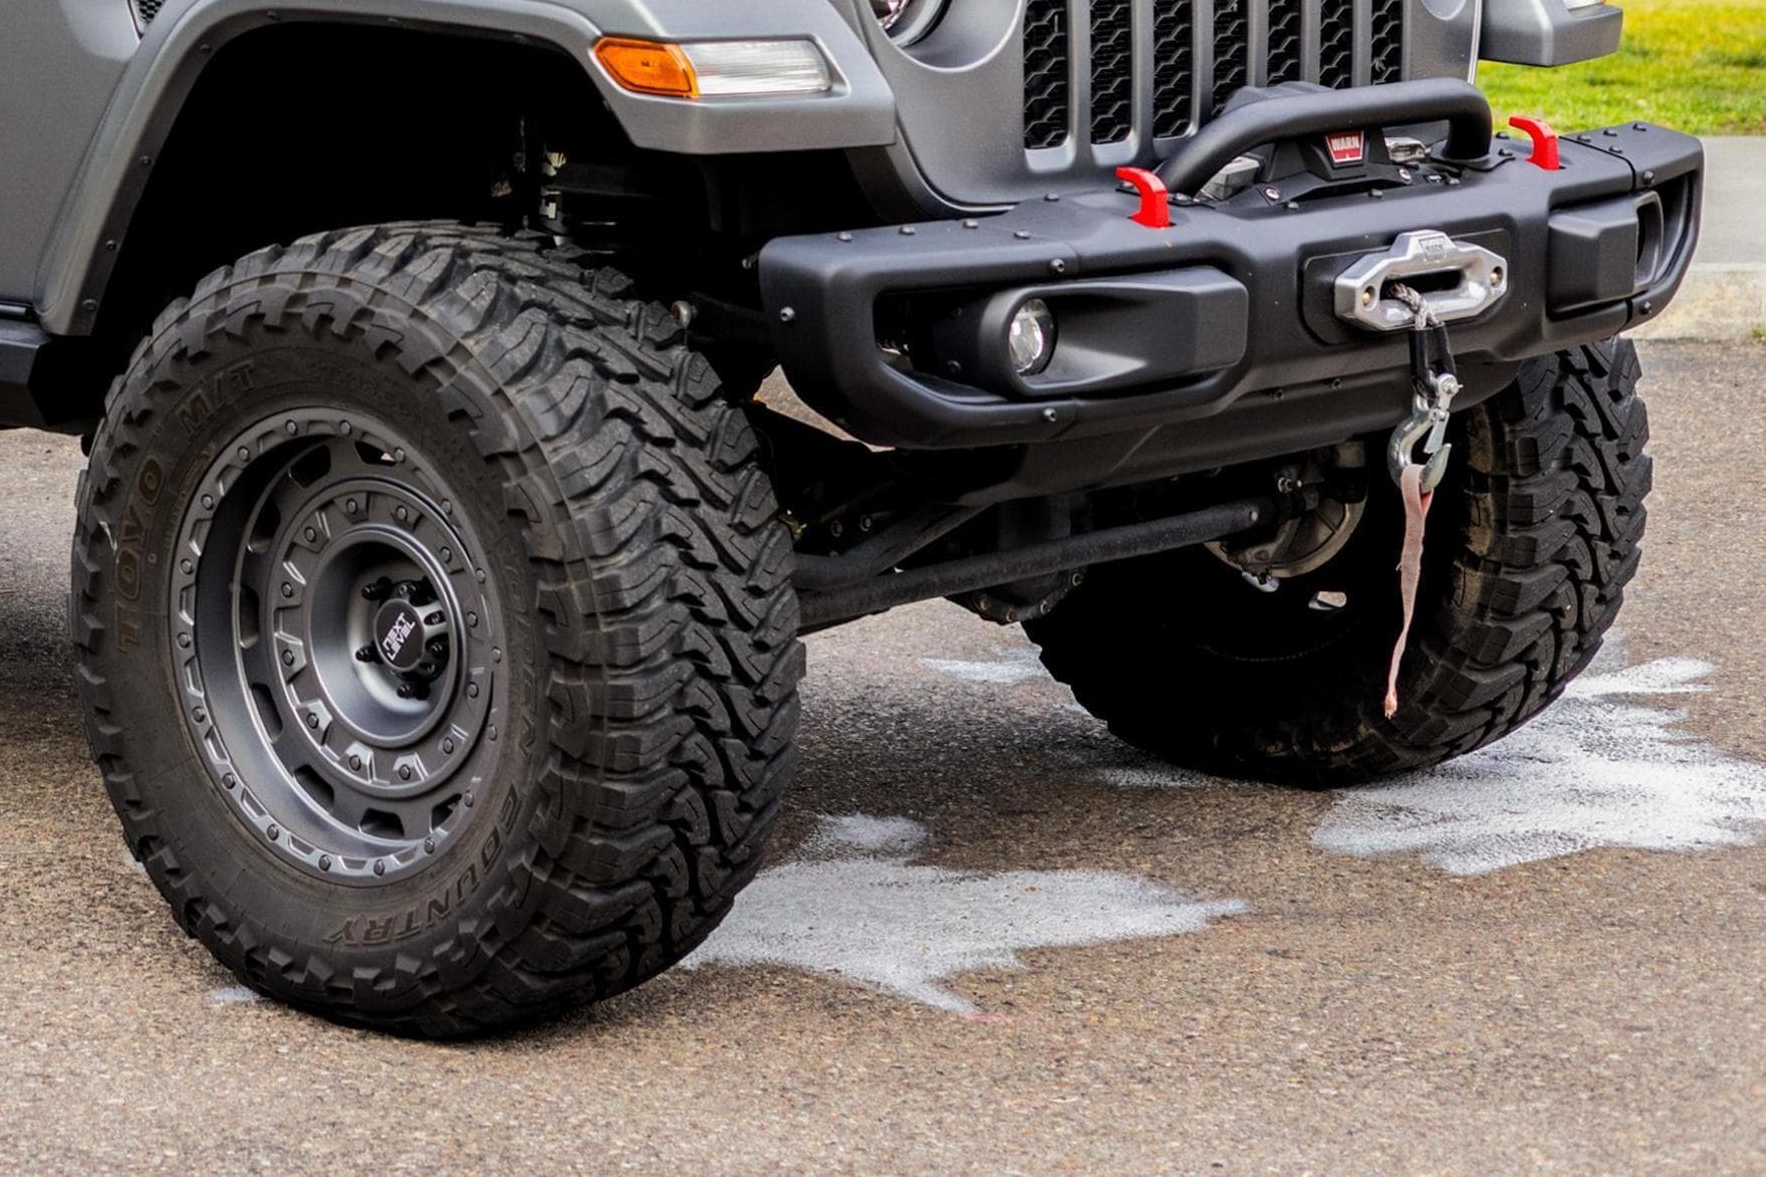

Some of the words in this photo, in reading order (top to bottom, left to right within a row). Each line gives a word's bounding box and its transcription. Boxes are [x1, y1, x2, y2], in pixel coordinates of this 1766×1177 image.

[114, 454, 166, 654] TOYO
[382, 612, 406, 651] NEXT
[387, 621, 415, 660] LEVEL
[322, 779, 523, 947] COUNTRY
